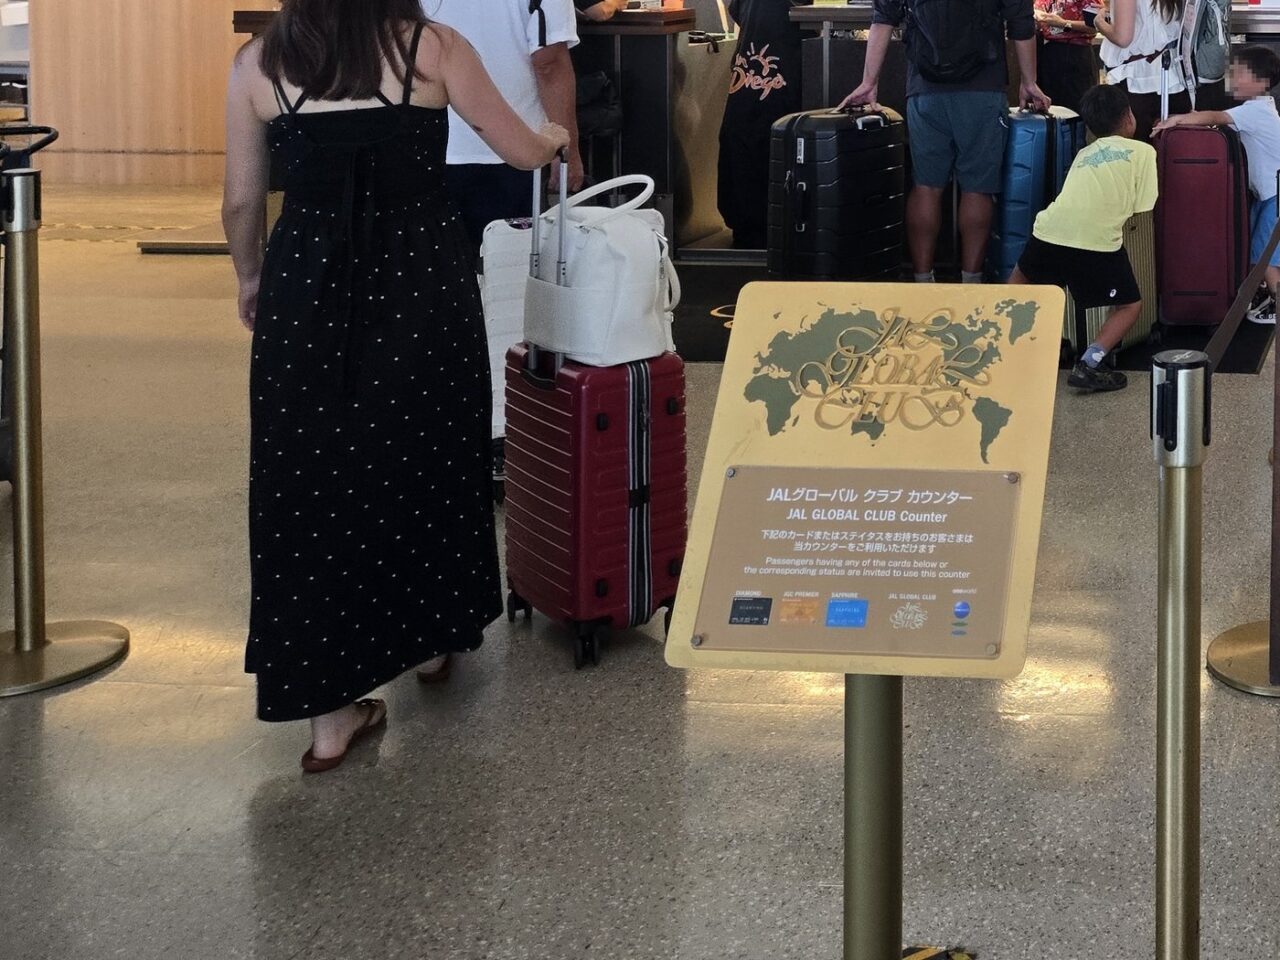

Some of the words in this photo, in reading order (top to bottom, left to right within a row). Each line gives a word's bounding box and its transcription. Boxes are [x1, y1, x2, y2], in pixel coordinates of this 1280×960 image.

[728, 67, 786, 100] Diego
[766, 488, 858, 503] JALグローバル
[864, 489, 903, 503] クラブ
[907, 490, 972, 504] カウンター
[786, 508, 807, 520] JAL
[812, 509, 859, 521] GLOBAL
[864, 510, 896, 522] CLUB
[900, 510, 948, 522] Counter
[761, 530, 973, 544] 下記のカードまたはステイタスをお持ちのお客さまは
[793, 542, 936, 554] 当カウンターをご利用いただけます
[766, 556, 814, 566] Passengers
[816, 558, 842, 567] having
[759, 567, 816, 576] corresponding
[819, 567, 845, 575] status
